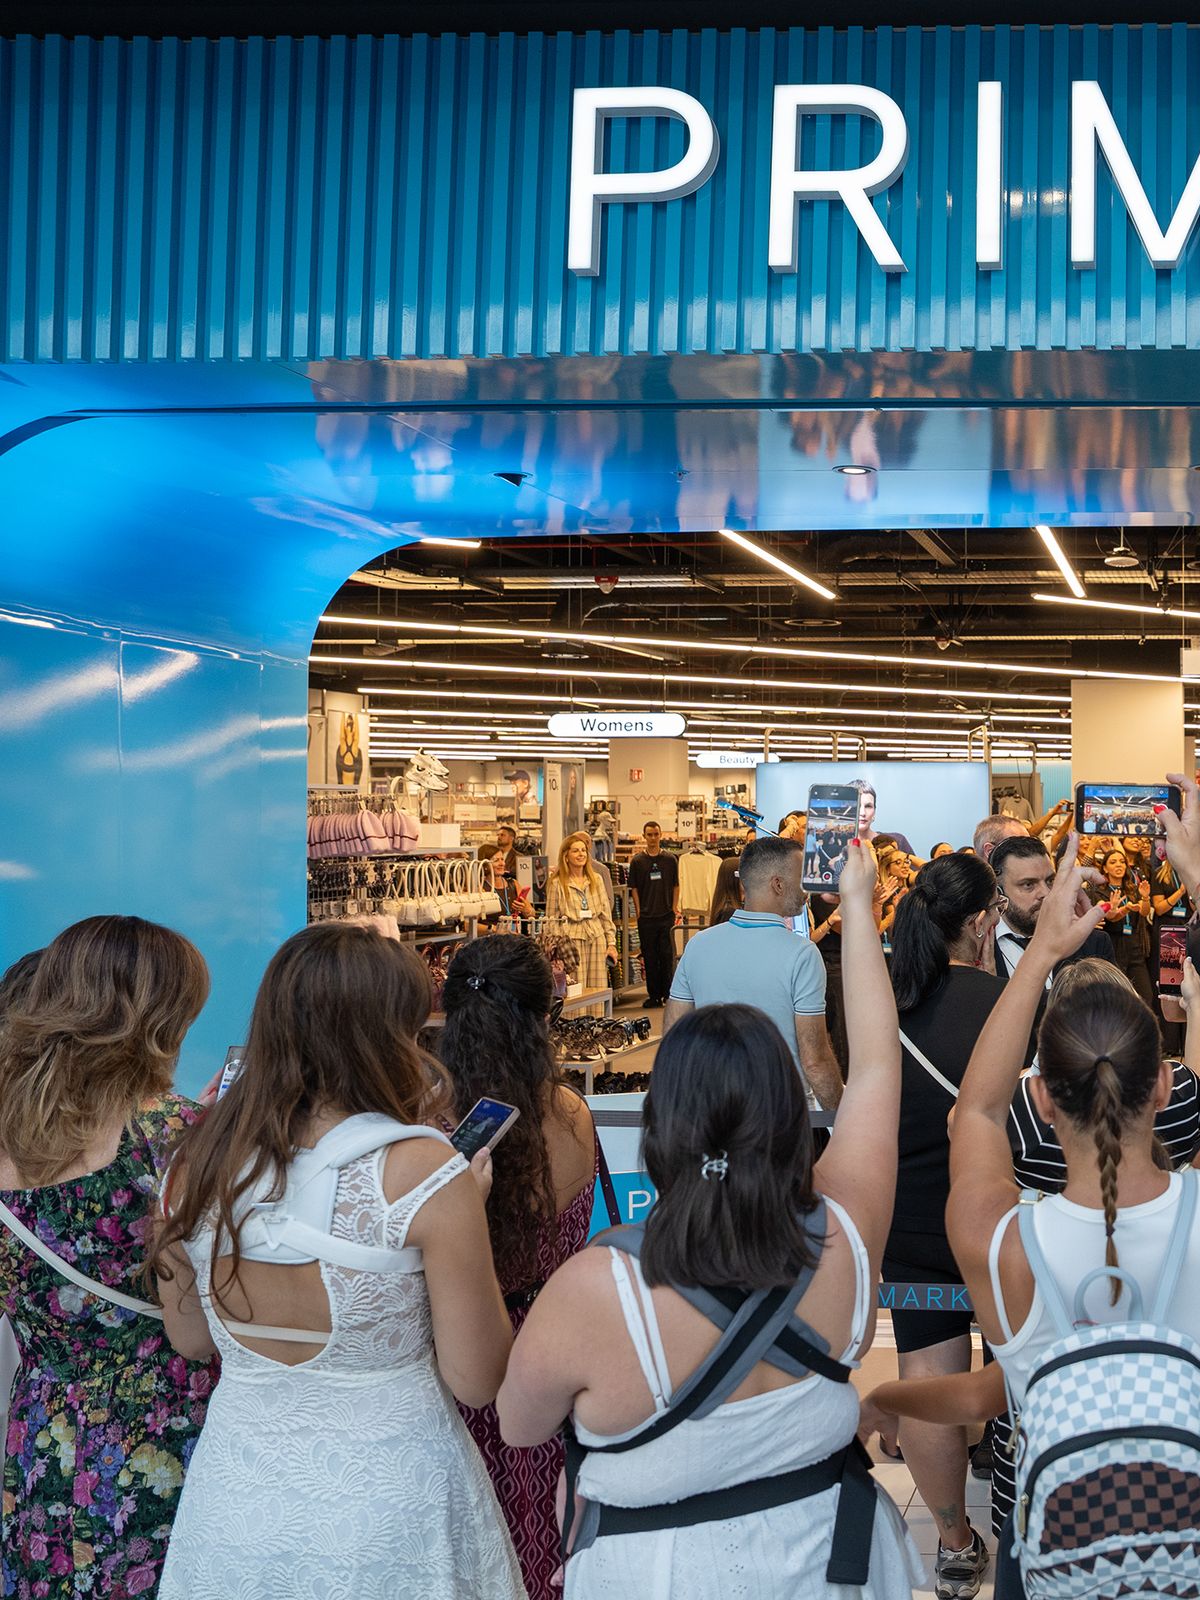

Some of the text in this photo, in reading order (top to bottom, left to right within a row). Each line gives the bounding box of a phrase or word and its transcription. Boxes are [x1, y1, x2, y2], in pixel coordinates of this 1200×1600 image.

[580, 718, 654, 733] Womens
[719, 755, 756, 766] Beauty
[879, 1286, 968, 1310] MARK
